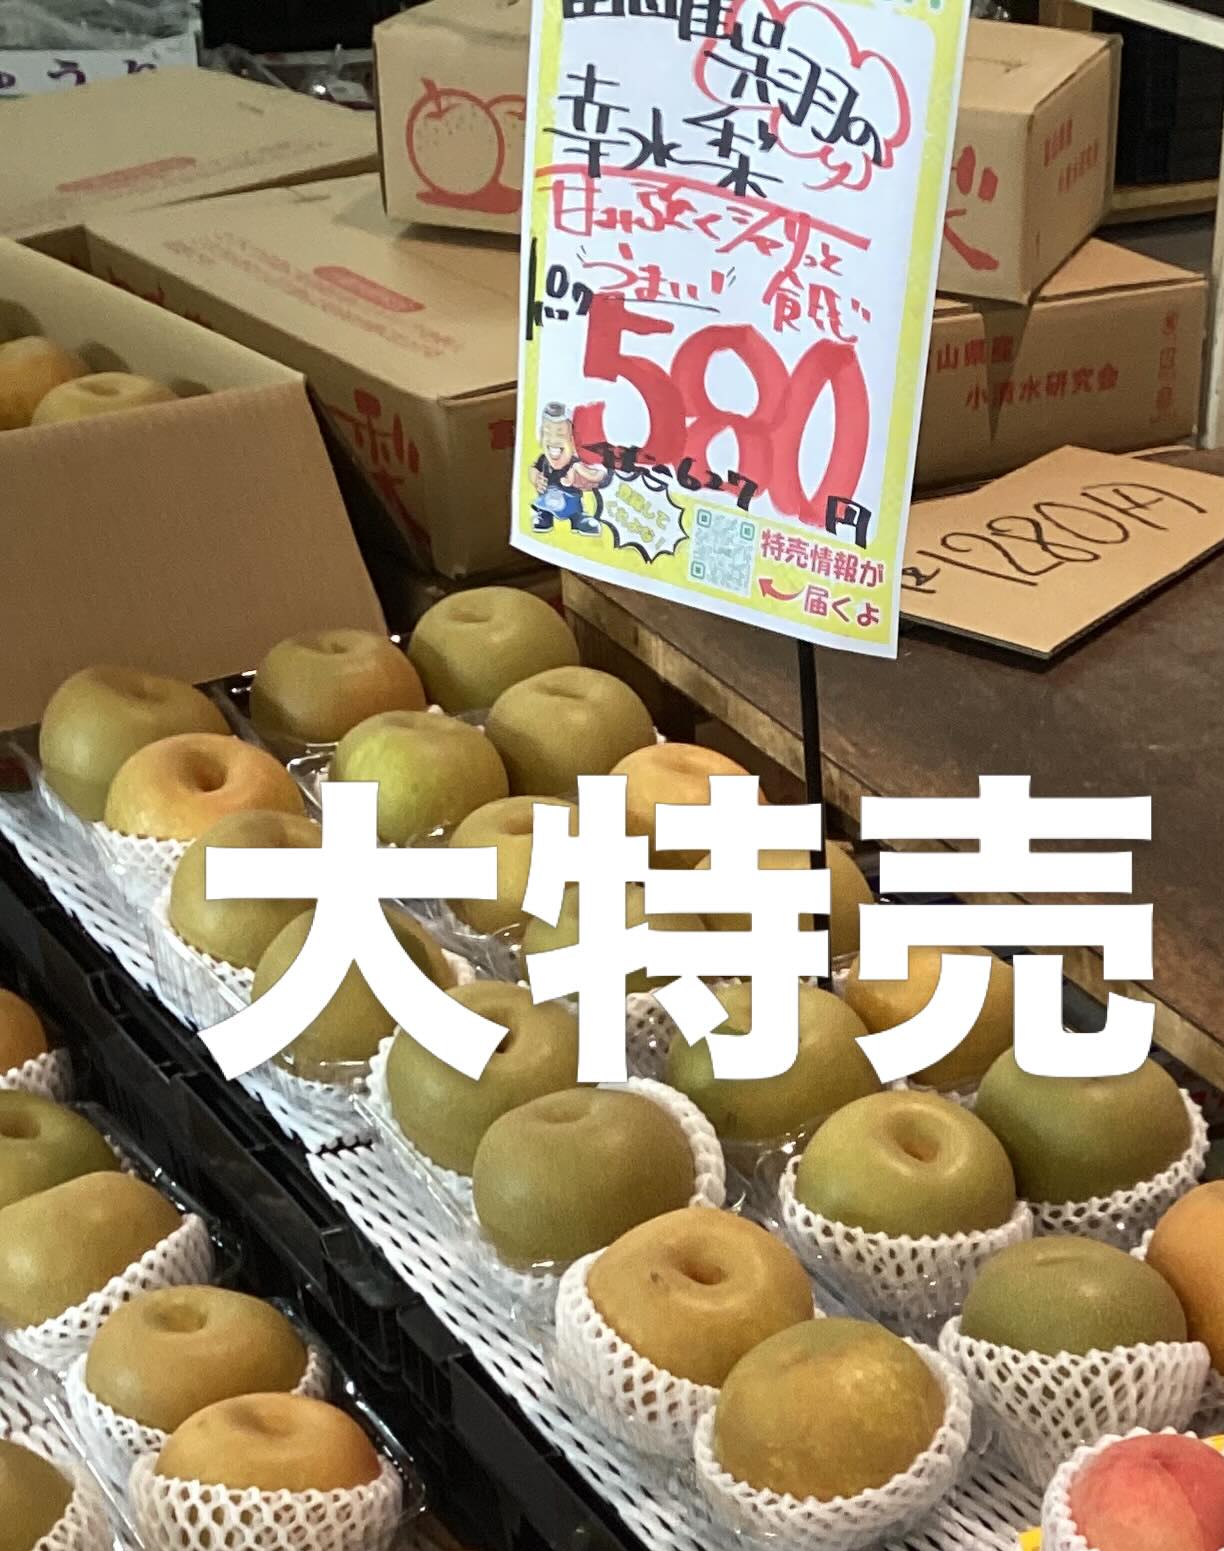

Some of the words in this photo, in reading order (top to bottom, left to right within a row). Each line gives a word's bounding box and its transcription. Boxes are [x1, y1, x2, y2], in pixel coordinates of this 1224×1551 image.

[543, 63, 785, 198] 幸水梨
[929, 335, 1015, 374] 山県産
[571, 292, 871, 529] 580
[825, 495, 873, 550] 円
[760, 527, 886, 588] 特売情報が
[803, 585, 880, 628] 届くよ
